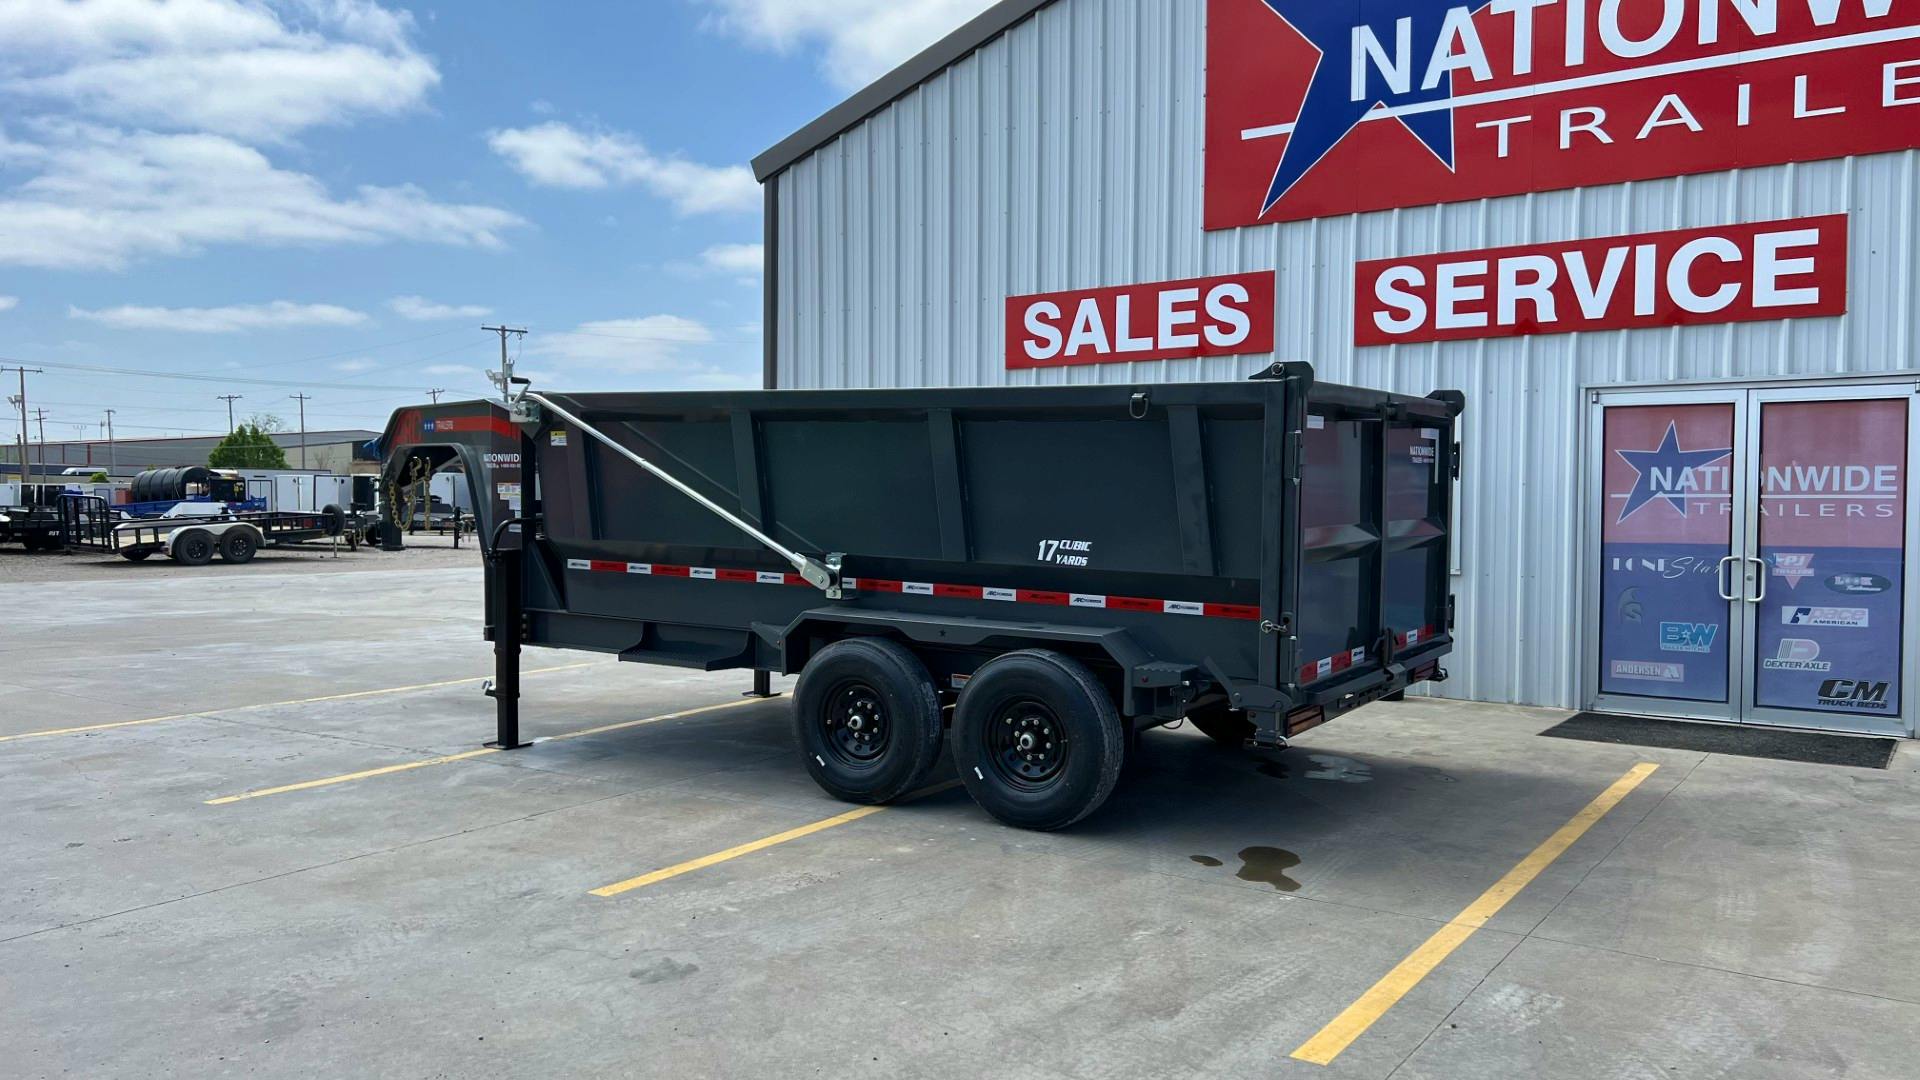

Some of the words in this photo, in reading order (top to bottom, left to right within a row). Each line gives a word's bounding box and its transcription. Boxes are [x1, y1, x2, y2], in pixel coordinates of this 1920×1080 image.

[1372, 228, 1820, 335] SERVICE
[1023, 283, 1251, 360] SALES
[1650, 465, 1898, 492] NATINWIDE
[1037, 539, 1060, 561] 17
[1060, 539, 1093, 552] CUBIC
[1056, 554, 1089, 567] YARDS
[1616, 663, 1661, 676] ANDERSEN
[1764, 660, 1803, 669] DEXTER
[1802, 661, 1830, 670] AXLE
[1817, 679, 1889, 702] CM
[1817, 699, 1855, 708] TRUCK
